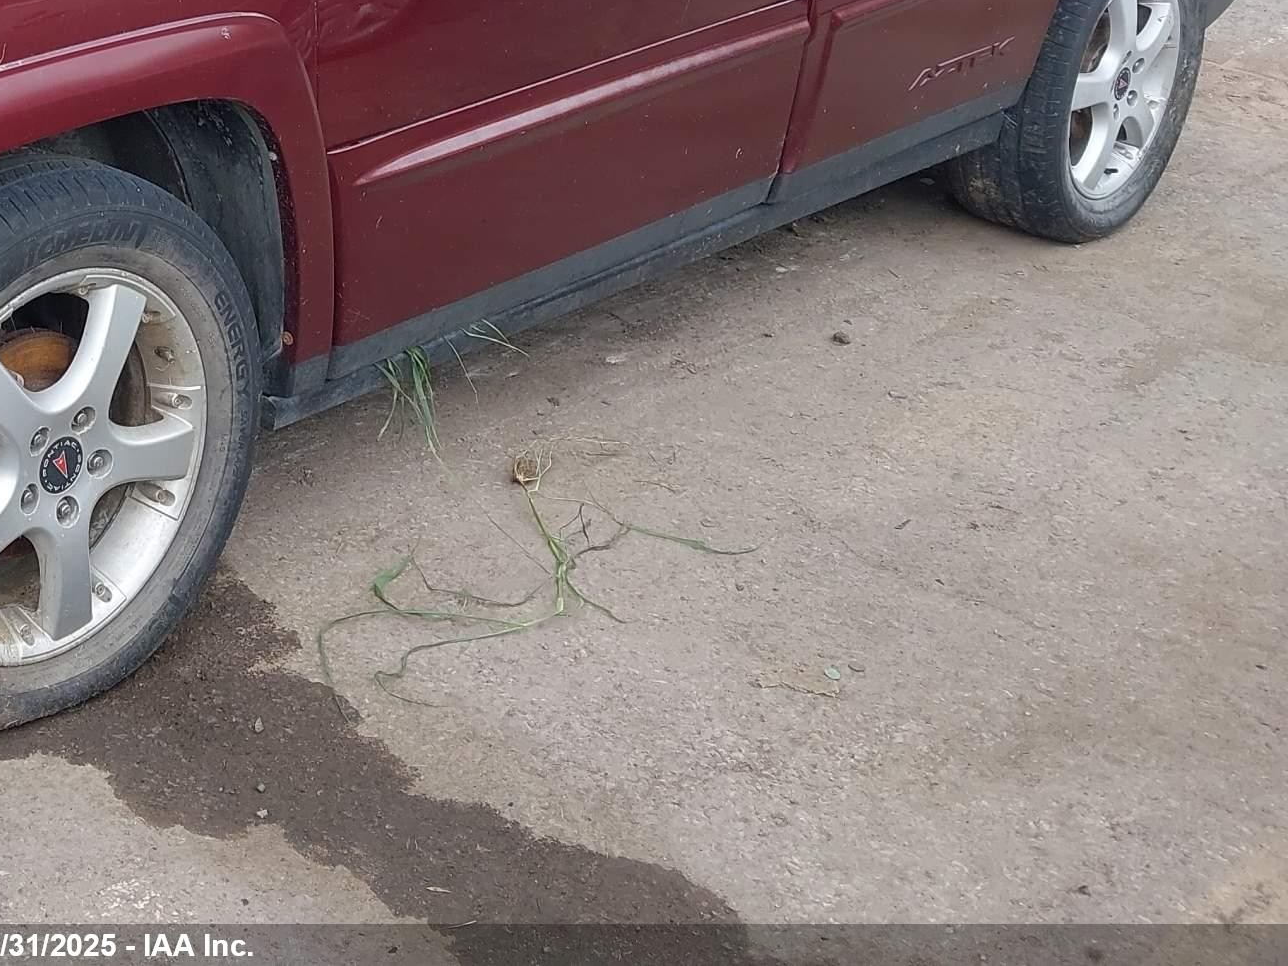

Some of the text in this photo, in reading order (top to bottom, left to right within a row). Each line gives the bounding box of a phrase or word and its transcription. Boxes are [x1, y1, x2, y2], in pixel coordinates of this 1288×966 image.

[24, 219, 141, 266] ICHELIN
[213, 291, 250, 399] ENERGY
[43, 439, 77, 477] PONTIAC
